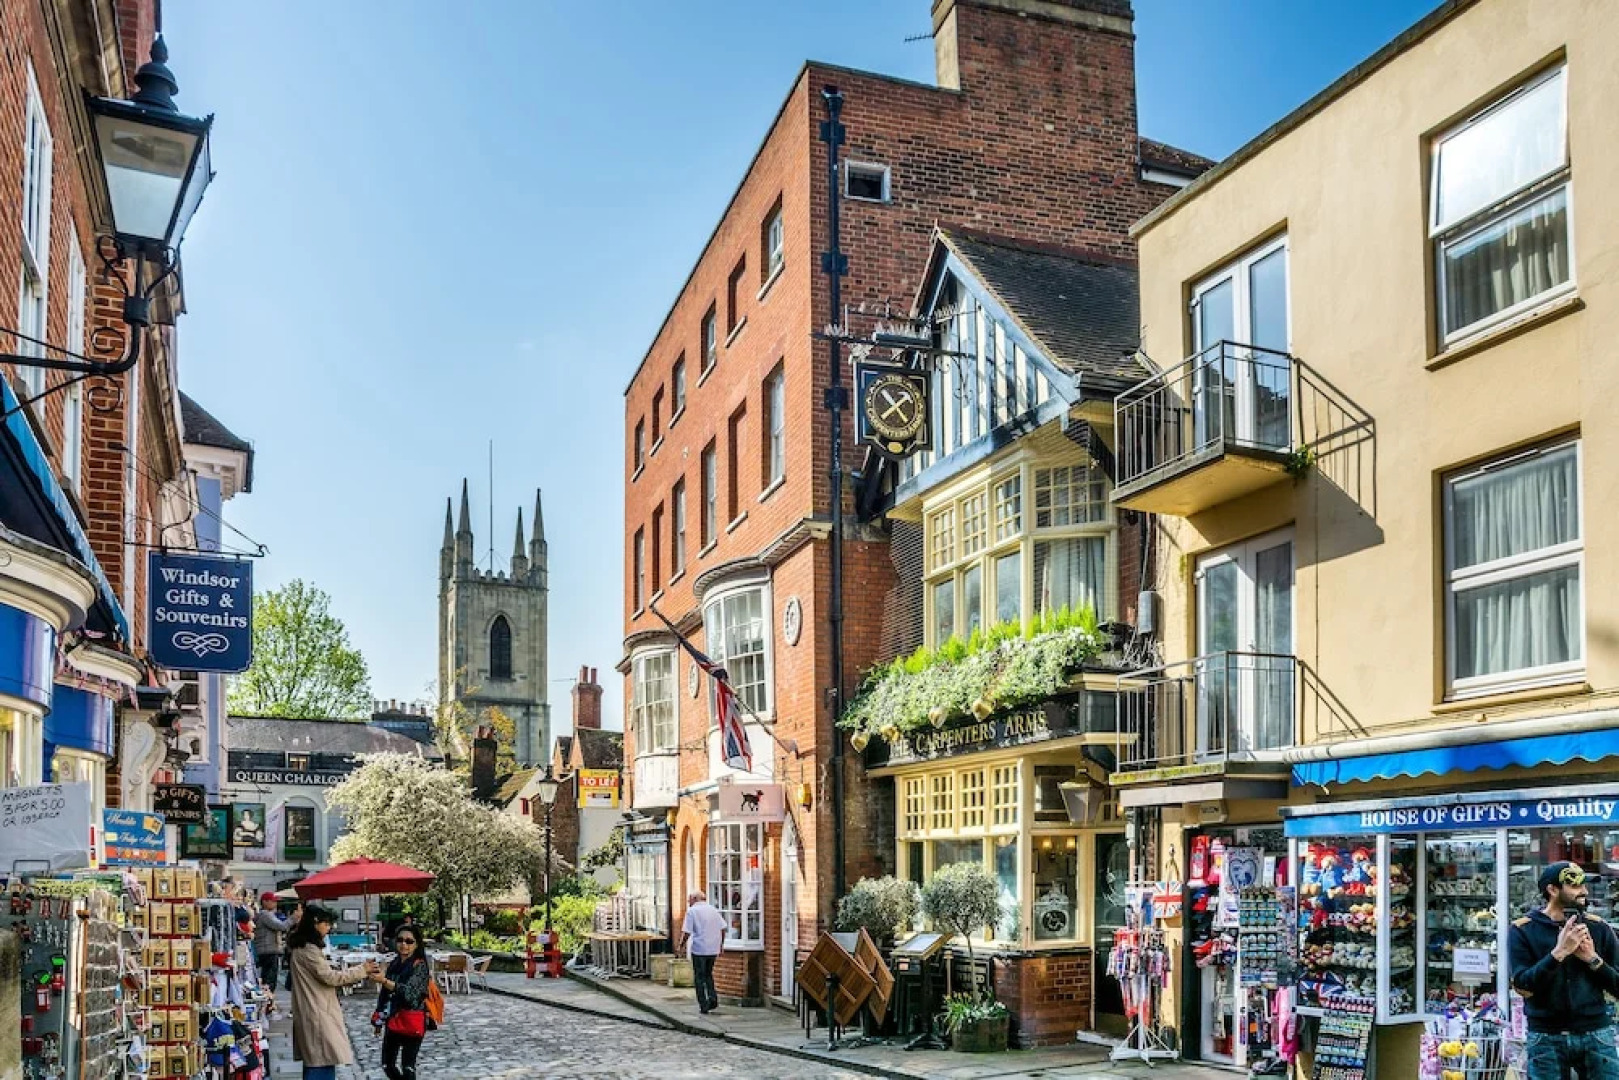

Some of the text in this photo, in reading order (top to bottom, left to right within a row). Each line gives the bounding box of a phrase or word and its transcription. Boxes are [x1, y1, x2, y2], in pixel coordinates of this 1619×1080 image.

[160, 567, 240, 589] Windsor
[165, 589, 234, 609] Gifts &
[155, 606, 247, 628] Souvenirs
[916, 720, 997, 753] CARPENTERS
[1004, 710, 1049, 738] ARMS
[235, 770, 344, 785] QUEEN CHARLOT
[583, 777, 615, 786] TO LET
[2, 785, 62, 803] MAGNETS
[169, 787, 200, 803] GIFTS
[3, 804, 13, 815] 3
[15, 801, 38, 813] FOR
[1360, 799, 1615, 828] HOUSE OF GIFTS Quality
